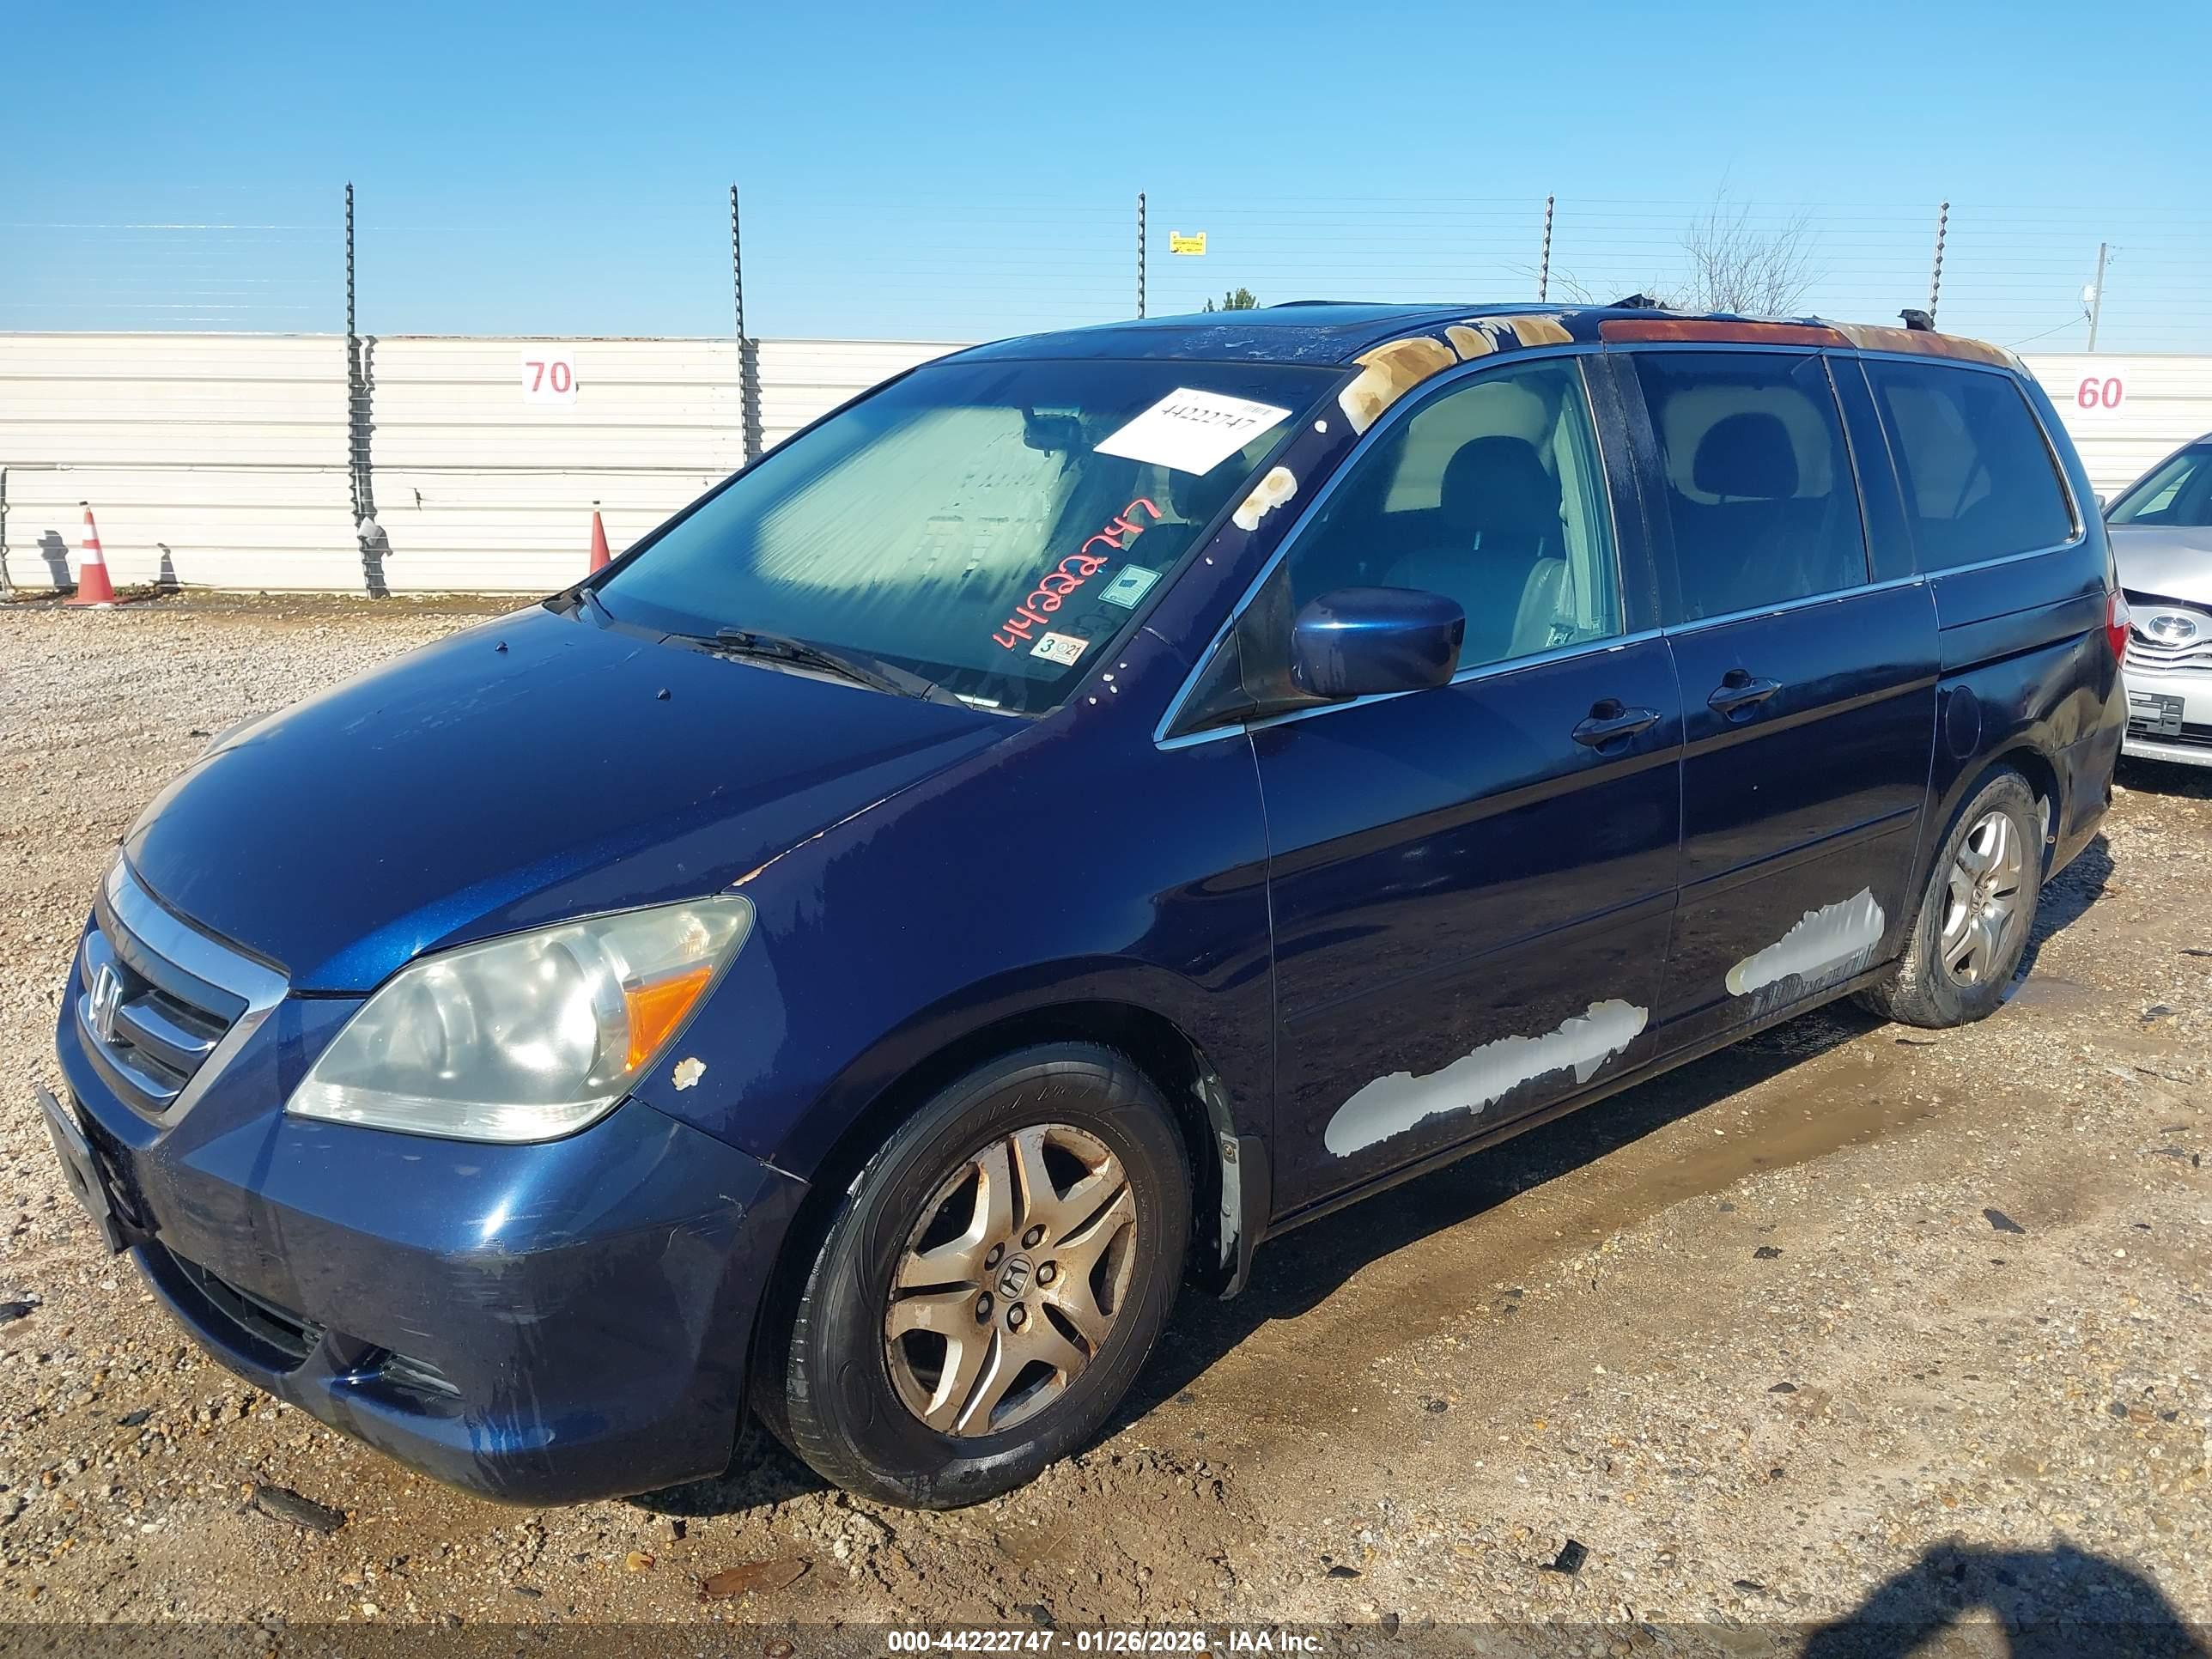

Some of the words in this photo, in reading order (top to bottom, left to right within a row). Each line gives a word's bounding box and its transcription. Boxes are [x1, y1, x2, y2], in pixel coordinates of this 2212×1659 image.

[525, 362, 571, 393] 70
[2076, 376, 2124, 410] 60
[1161, 404, 1257, 430] 44222747
[992, 497, 1162, 652] 44222747
[1040, 638, 1055, 653] 3
[1065, 644, 1082, 657] 21
